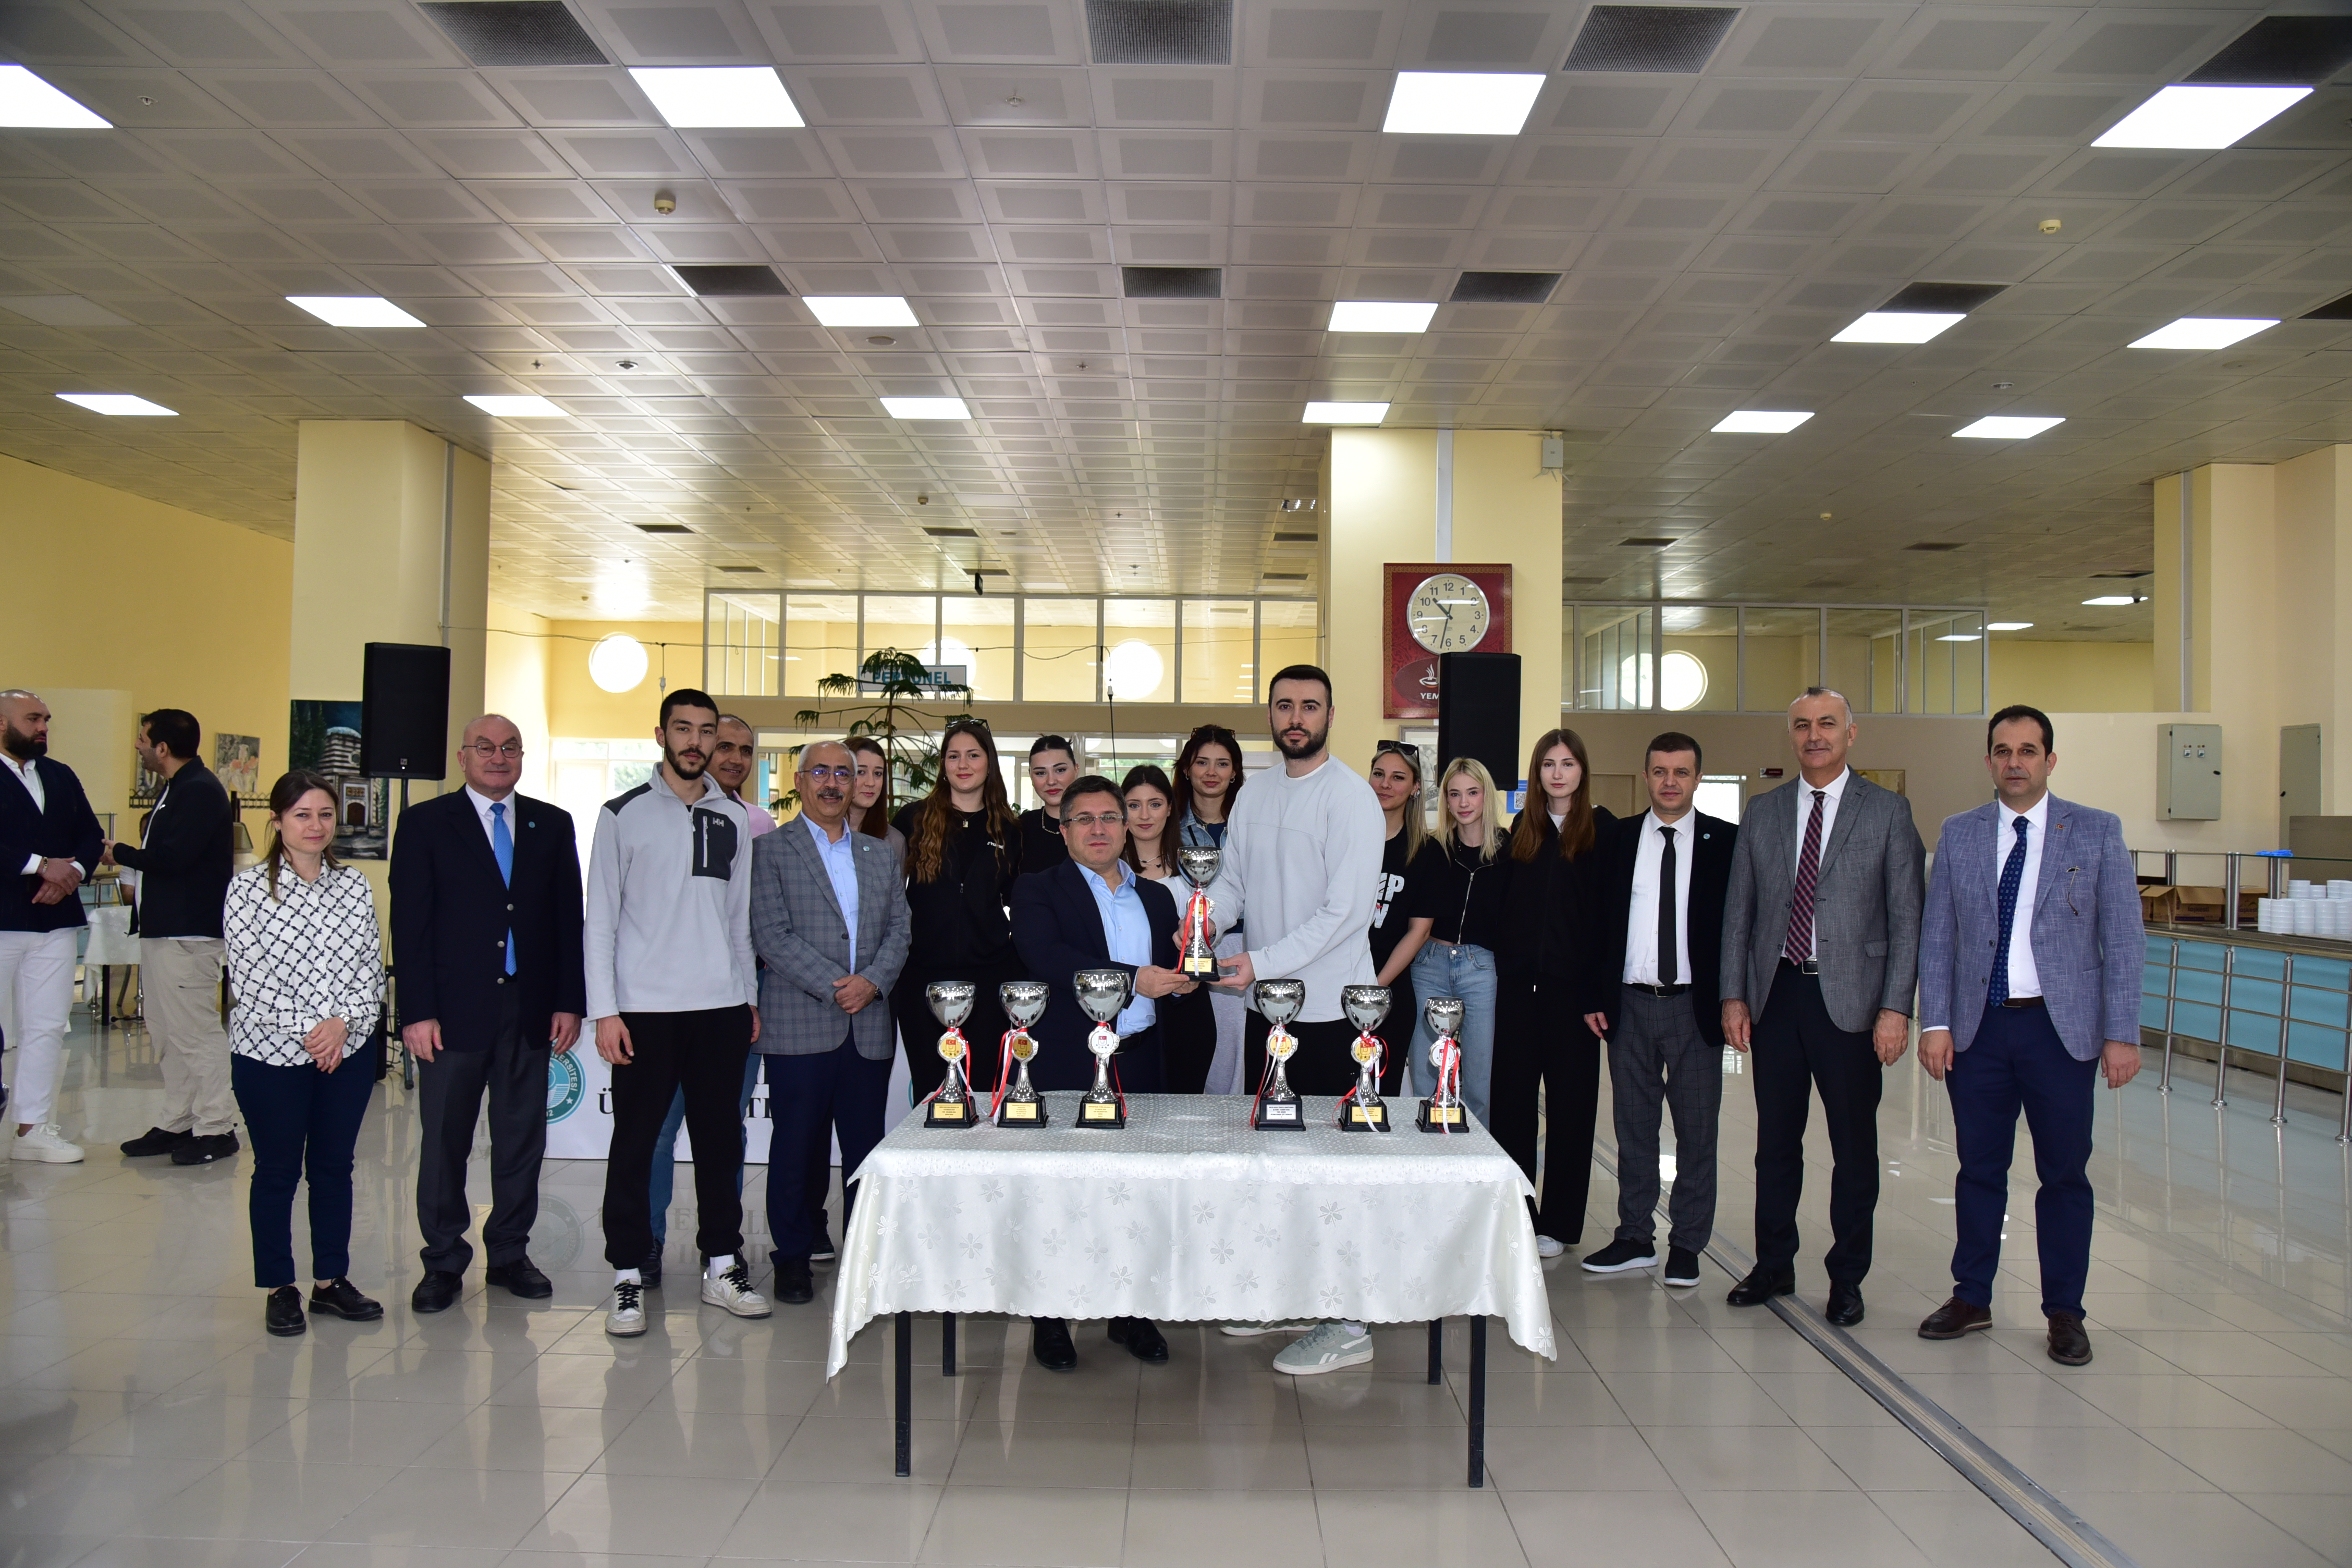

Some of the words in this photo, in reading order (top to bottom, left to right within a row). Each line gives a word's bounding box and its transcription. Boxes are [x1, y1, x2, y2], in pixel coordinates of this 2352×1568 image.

[1429, 587, 1438, 595] 11
[1443, 582, 1454, 591] 12
[1460, 587, 1464, 595] 1
[1420, 597, 1431, 606] 10
[1471, 597, 1477, 606] 2
[1416, 610, 1423, 619] 9
[1474, 611, 1481, 620] 3
[1422, 624, 1428, 633] 8
[1469, 624, 1476, 633] 4
[1431, 635, 1438, 644] 7
[1446, 638, 1452, 647] 6
[1459, 635, 1466, 644] 5
[873, 671, 951, 684] PERONEL
